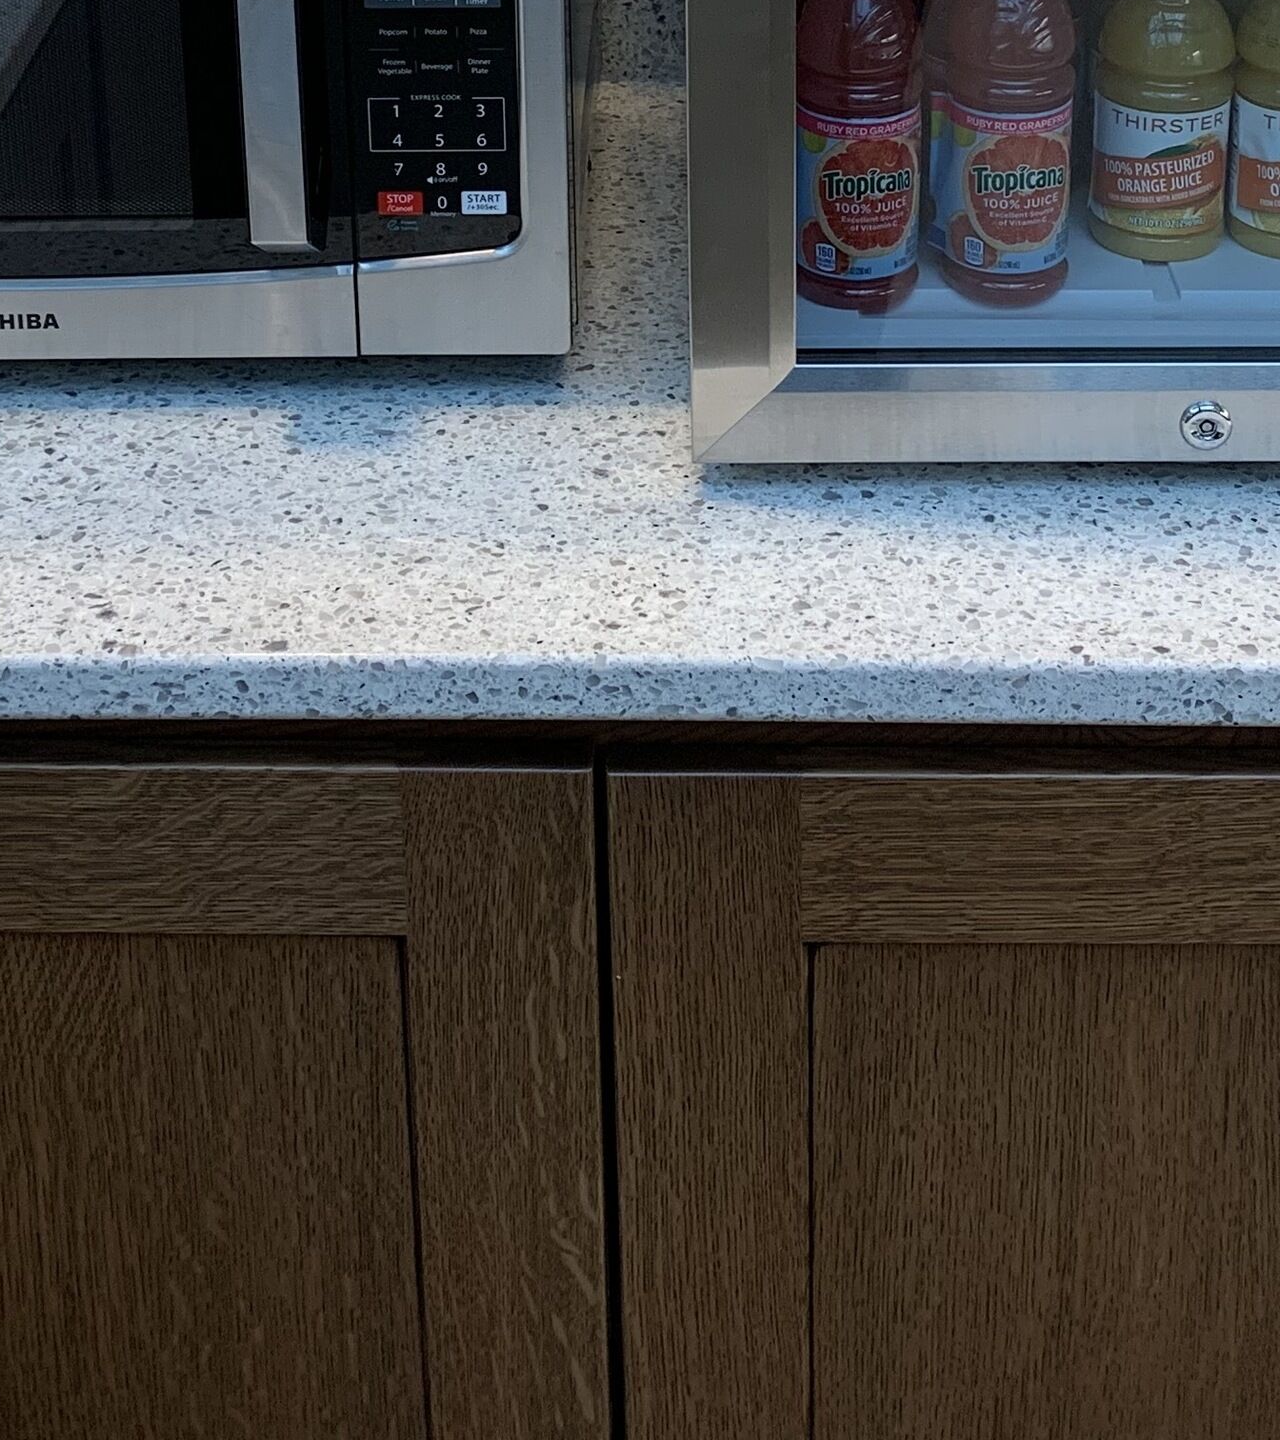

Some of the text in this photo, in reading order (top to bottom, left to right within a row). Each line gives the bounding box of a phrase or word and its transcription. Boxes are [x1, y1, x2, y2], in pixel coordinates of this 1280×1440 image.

[379, 28, 408, 36] Popcorn
[424, 27, 448, 35] Potato
[469, 27, 487, 35] Pizza
[382, 58, 406, 66] Frozen
[392, 104, 399, 118] 1
[433, 104, 444, 118] 2
[475, 103, 486, 118] 3
[967, 116, 993, 129] RUBY
[994, 120, 1017, 131] RED
[1112, 108, 1224, 134] THIRSTER
[817, 122, 845, 135] RUBY
[845, 126, 868, 136] RED
[392, 133, 403, 147] 4
[435, 133, 445, 147] 5
[476, 133, 487, 147] 6
[394, 162, 404, 176] 7
[435, 162, 446, 176] 8
[477, 162, 488, 176] 9
[1104, 149, 1215, 177] 100% PASTEURIZED
[822, 169, 911, 202] Tropicana
[972, 165, 1064, 197] Tropicana
[1117, 177, 1168, 193] ORANGE
[1170, 171, 1203, 192] JUICE
[386, 194, 414, 203] STOP
[437, 195, 448, 209] 0
[467, 193, 501, 203] START
[983, 191, 1059, 209] 100% JUICE
[835, 196, 907, 215] 100% JUICE
[841, 215, 879, 224] Excellent
[989, 210, 1029, 219] Excellent
[861, 223, 892, 232] Vitamin
[1010, 218, 1042, 226] Vitamin
